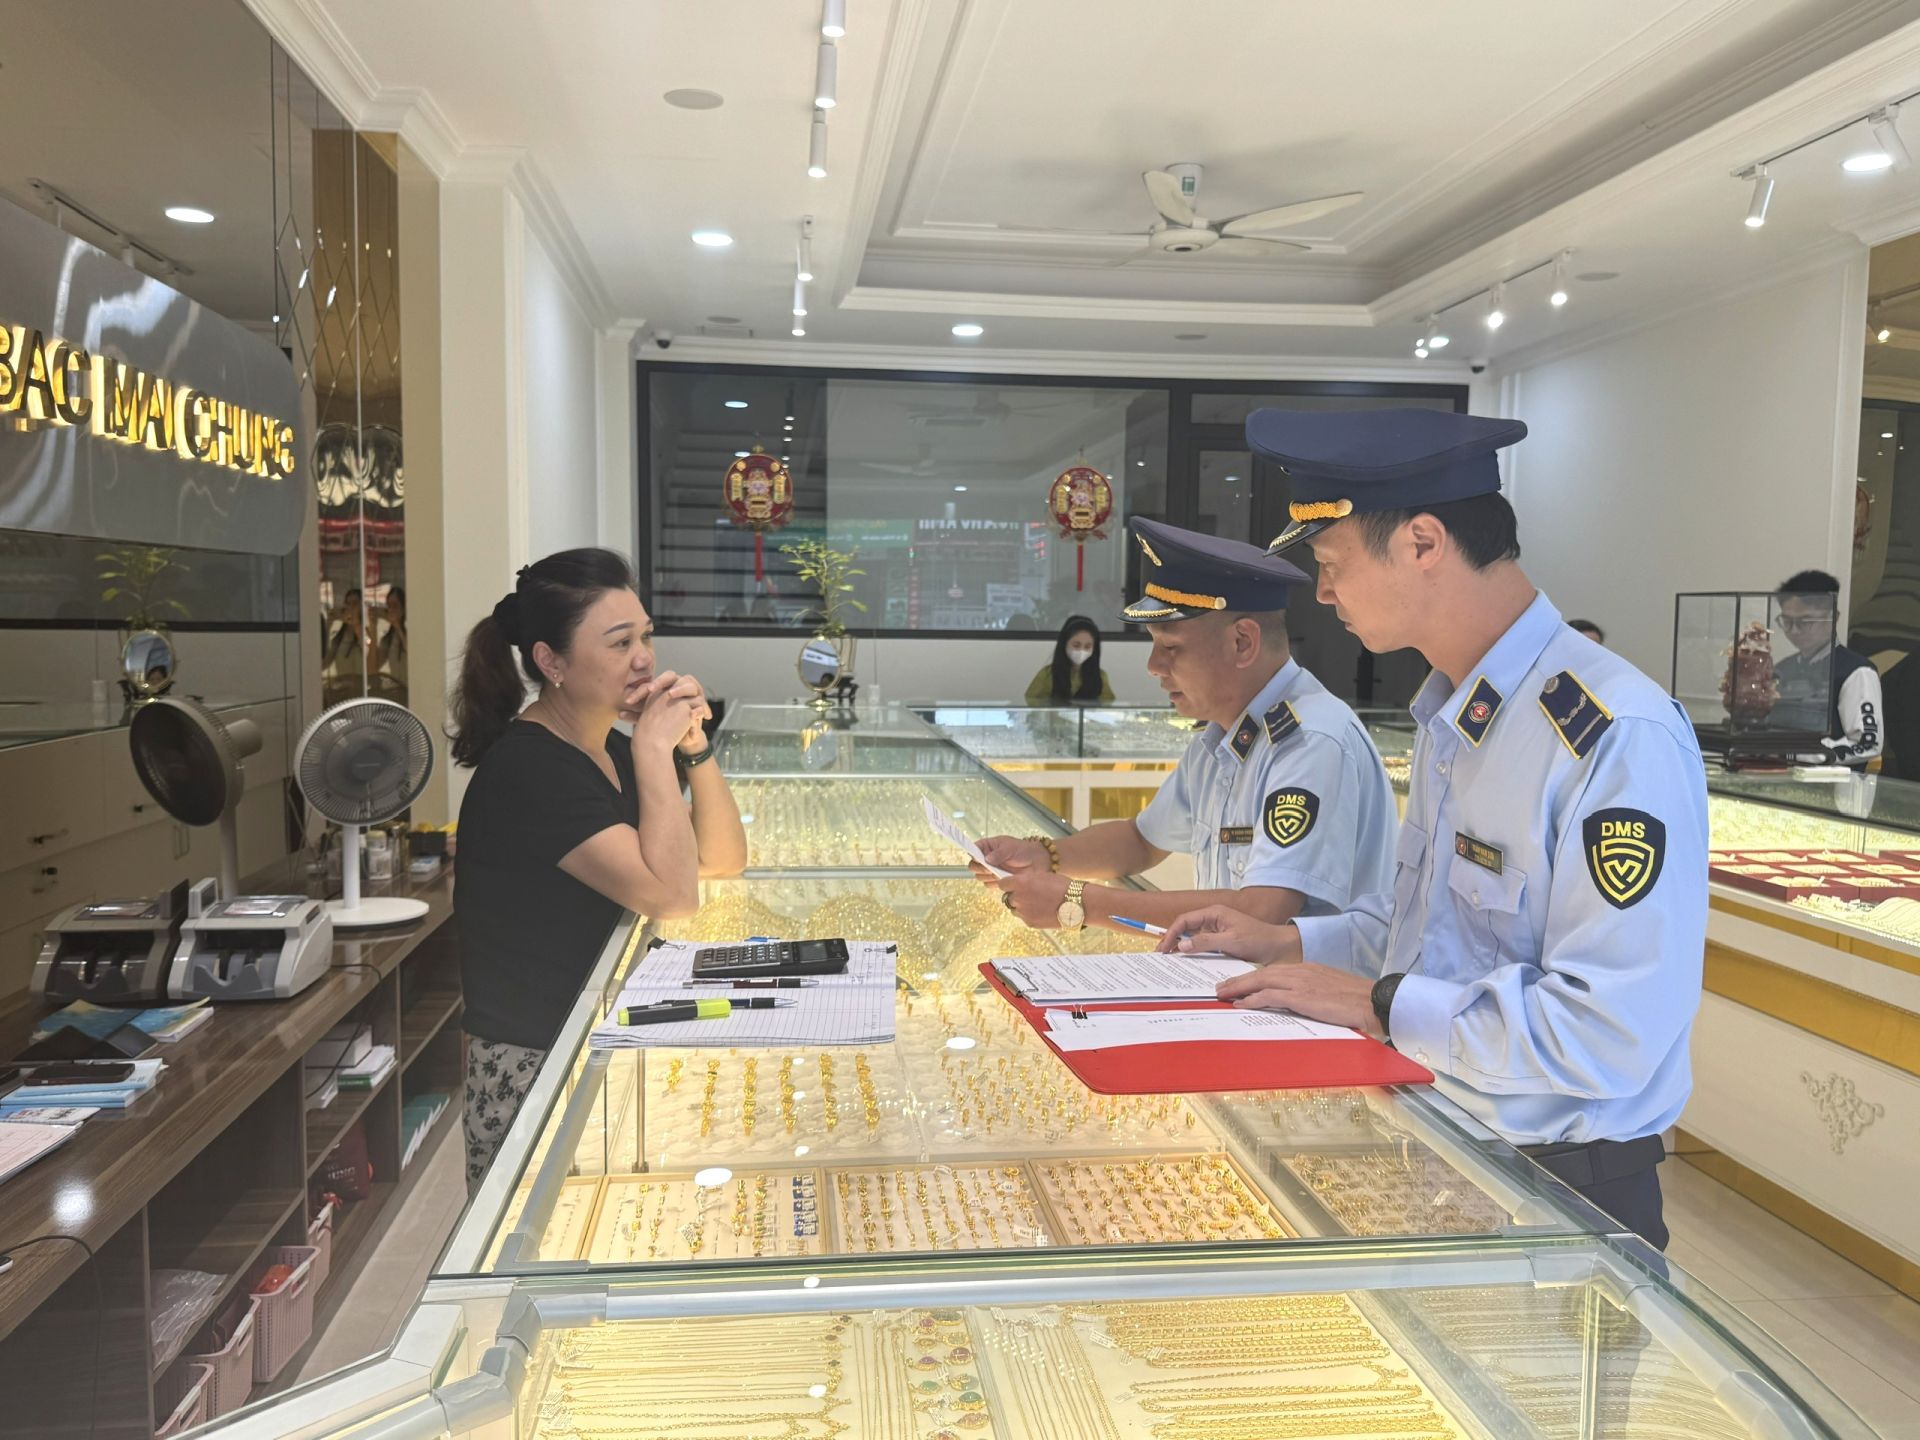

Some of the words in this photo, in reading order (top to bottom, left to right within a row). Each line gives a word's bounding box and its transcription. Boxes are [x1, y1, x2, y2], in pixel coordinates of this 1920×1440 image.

[174, 385, 295, 480] CHUNG
[1276, 794, 1307, 807] DMS
[1601, 820, 1646, 840] DMS
